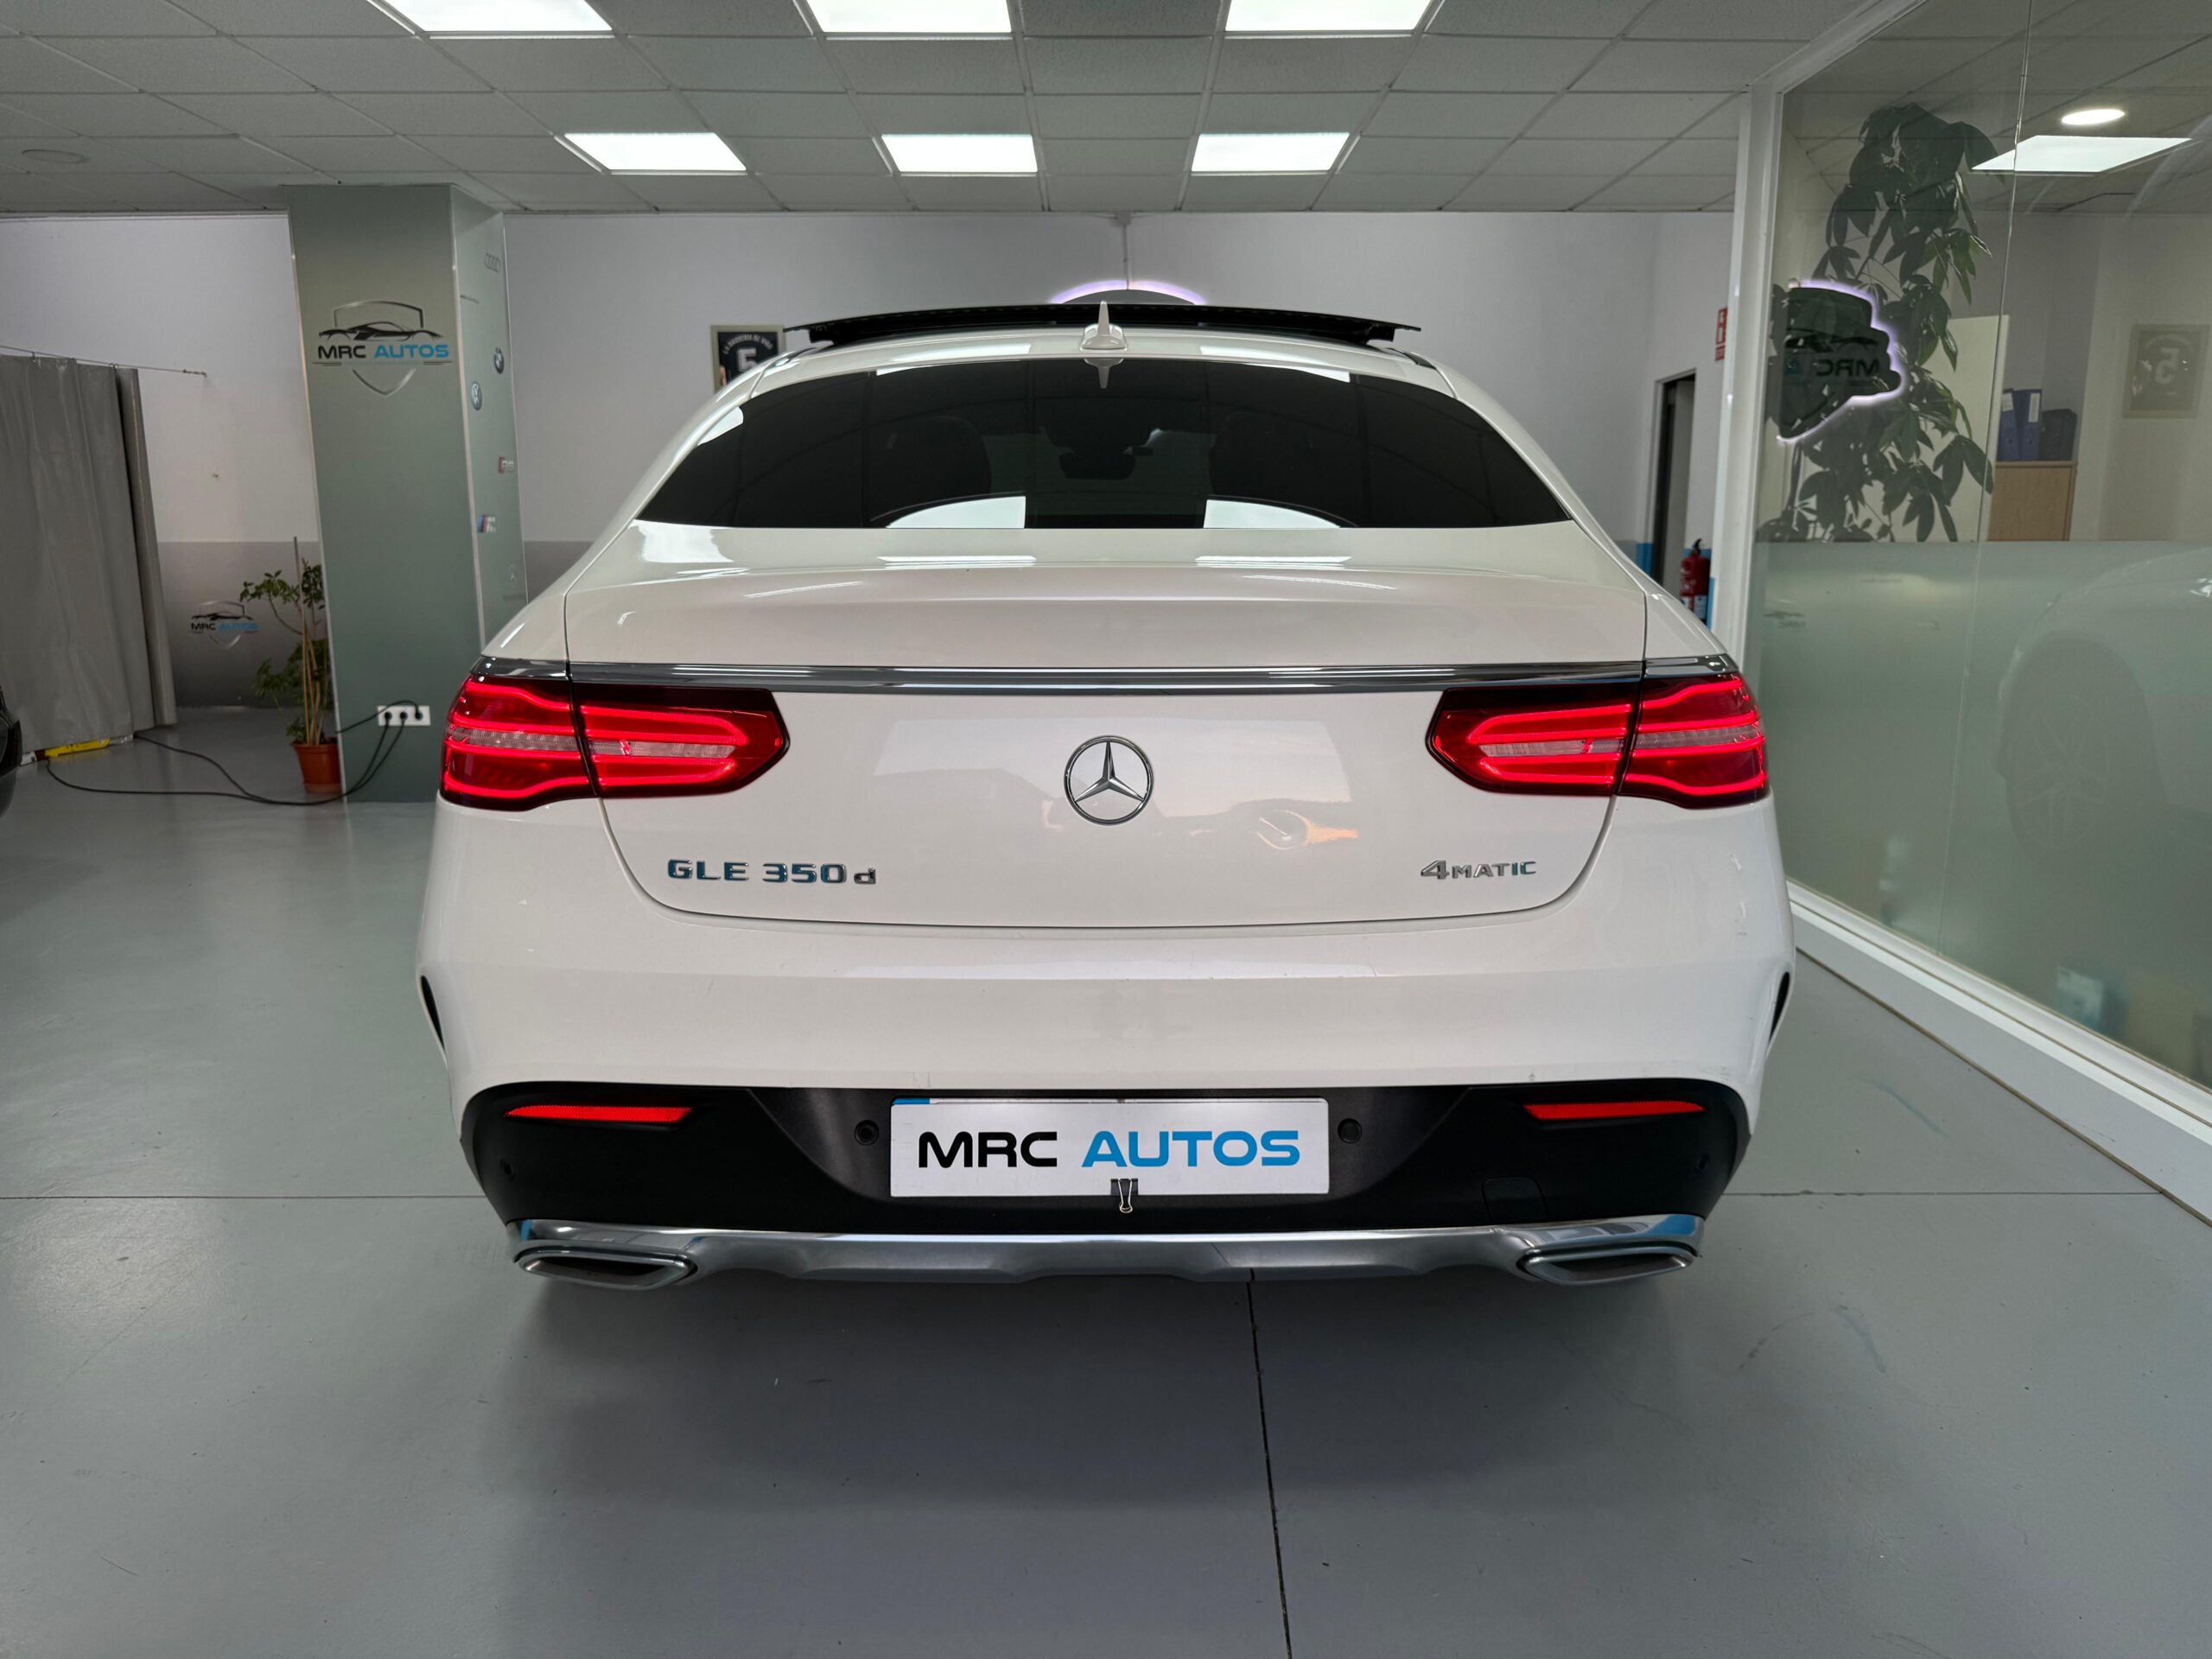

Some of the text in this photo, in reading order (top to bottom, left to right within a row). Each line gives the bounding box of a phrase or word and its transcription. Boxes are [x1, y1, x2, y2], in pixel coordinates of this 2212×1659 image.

[318, 344, 449, 359] MRC AUTOS
[191, 622, 215, 631] MRC
[668, 859, 749, 880] GLE
[1421, 860, 1536, 880] 4MATIC
[918, 1130, 1300, 1168] MRC AUTOS
